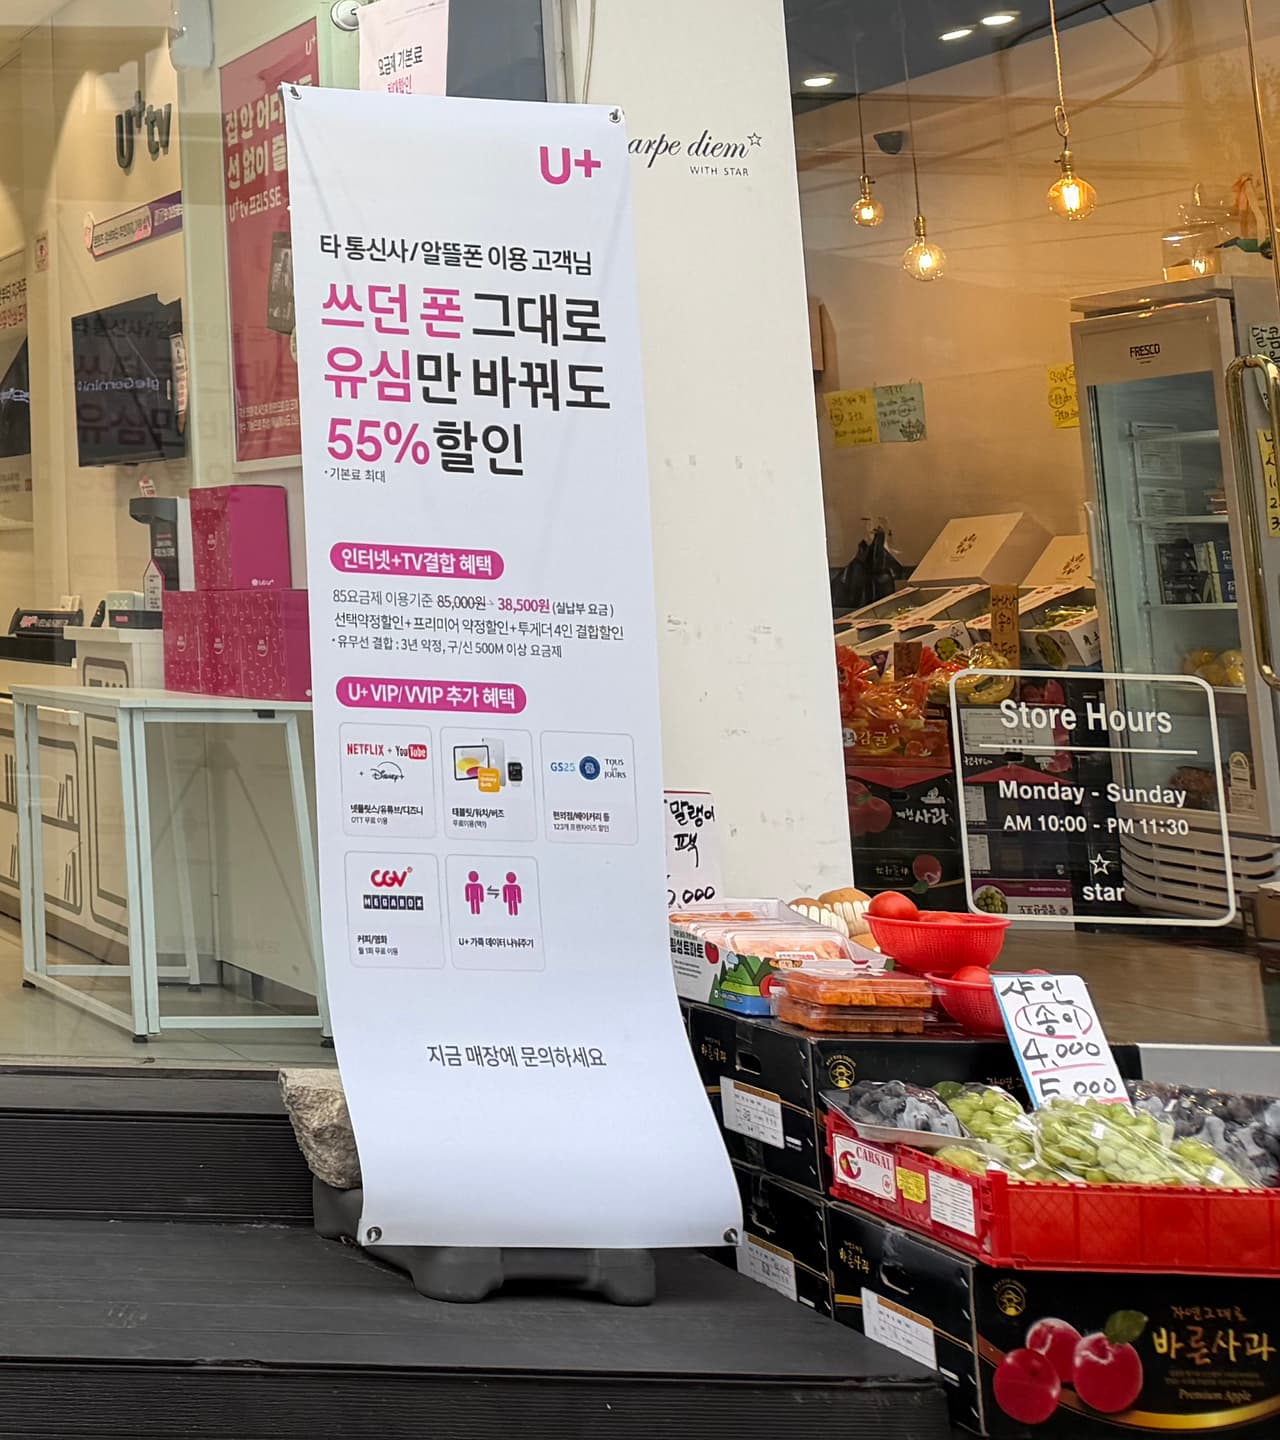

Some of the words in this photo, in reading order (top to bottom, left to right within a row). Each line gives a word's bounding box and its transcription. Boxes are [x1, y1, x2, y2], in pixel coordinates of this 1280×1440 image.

[239, 105, 255, 140] 안
[628, 133, 682, 169] arpe
[687, 129, 750, 159] diem
[539, 145, 602, 185] U+
[690, 166, 718, 176] WITH
[723, 167, 749, 177] STAR
[319, 234, 342, 260] 타
[344, 236, 484, 269] 통신사/알뜰폰
[489, 246, 528, 273] 이용
[531, 249, 593, 277] 고객님
[320, 282, 410, 337] 쓰던
[419, 287, 465, 339] 폰
[471, 292, 607, 348] 그대로
[324, 346, 462, 406] 유심만
[472, 355, 611, 411] 바꿔도
[329, 466, 362, 482] 기본료
[363, 467, 386, 484] 최대
[341, 546, 456, 574] 인터넷+TV결합
[458, 552, 492, 577] 혜택
[332, 589, 383, 606] 85요금제
[385, 591, 433, 609] 이용기준
[436, 594, 487, 611] 85,000원
[497, 597, 551, 614] 38,500원
[575, 624, 625, 641] 결합할인
[372, 636, 394, 652] 결합
[401, 637, 419, 653] 3년
[447, 640, 474, 656] 구/신
[475, 641, 505, 656] 500M
[507, 642, 527, 657] 이상
[530, 644, 563, 659] 요금제
[347, 683, 369, 702] U+
[446, 686, 480, 708] 추가
[481, 688, 516, 710] 혜택
[999, 698, 1077, 731] Store
[1086, 701, 1174, 735] Hours
[346, 743, 385, 757] NETFLIX
[395, 744, 428, 760] YouTube
[550, 762, 577, 773] GS25
[998, 779, 1085, 806] Monday
[1105, 783, 1187, 809] Sunday
[1003, 815, 1032, 832] AM
[1037, 814, 1088, 833] 10:00
[1107, 817, 1134, 835] PM
[1138, 817, 1190, 836] 11:30
[370, 868, 408, 889] CGV
[363, 895, 425, 911] MEGABOX
[1082, 883, 1126, 902] star
[1000, 978, 1075, 1005] 샤인
[1022, 1005, 1083, 1036] 1송이
[426, 1045, 462, 1066] 지금
[465, 1046, 519, 1069] 매장에
[521, 1046, 608, 1069] 문의하세요
[1022, 1038, 1101, 1069] 4,000
[1151, 1325, 1278, 1365] 바른사과
